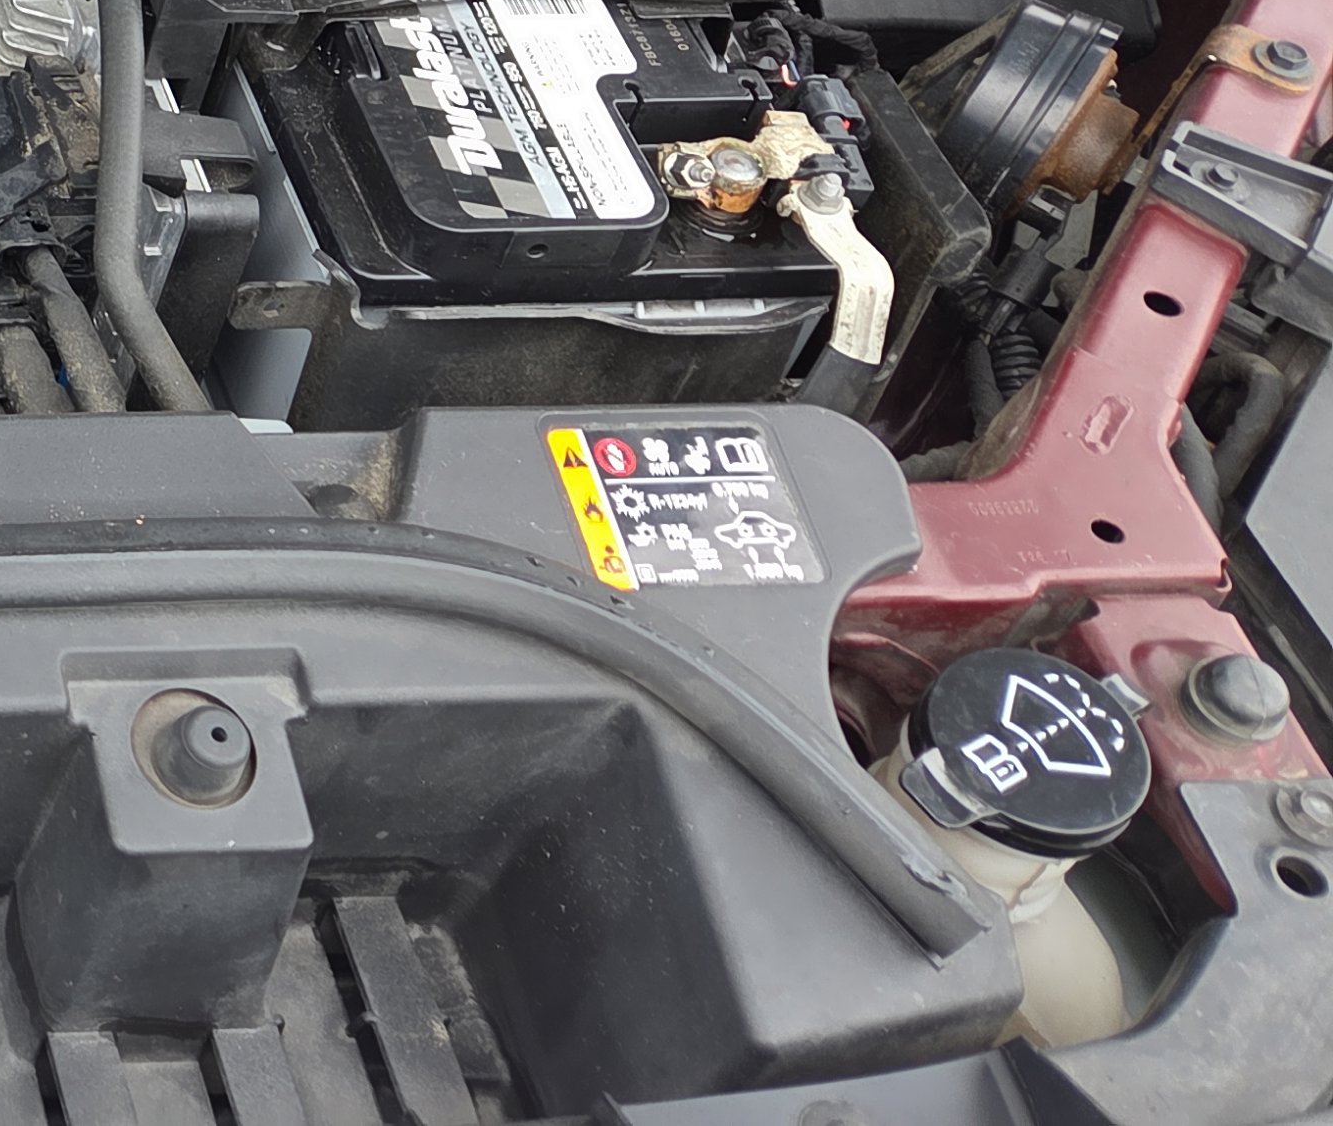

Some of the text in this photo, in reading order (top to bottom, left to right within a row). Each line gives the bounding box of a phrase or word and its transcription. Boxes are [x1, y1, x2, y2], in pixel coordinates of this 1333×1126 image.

[388, 16, 503, 174] Duralast
[432, 18, 493, 112] PLATINUM
[460, 22, 543, 166] AGM TECHNOLOGY
